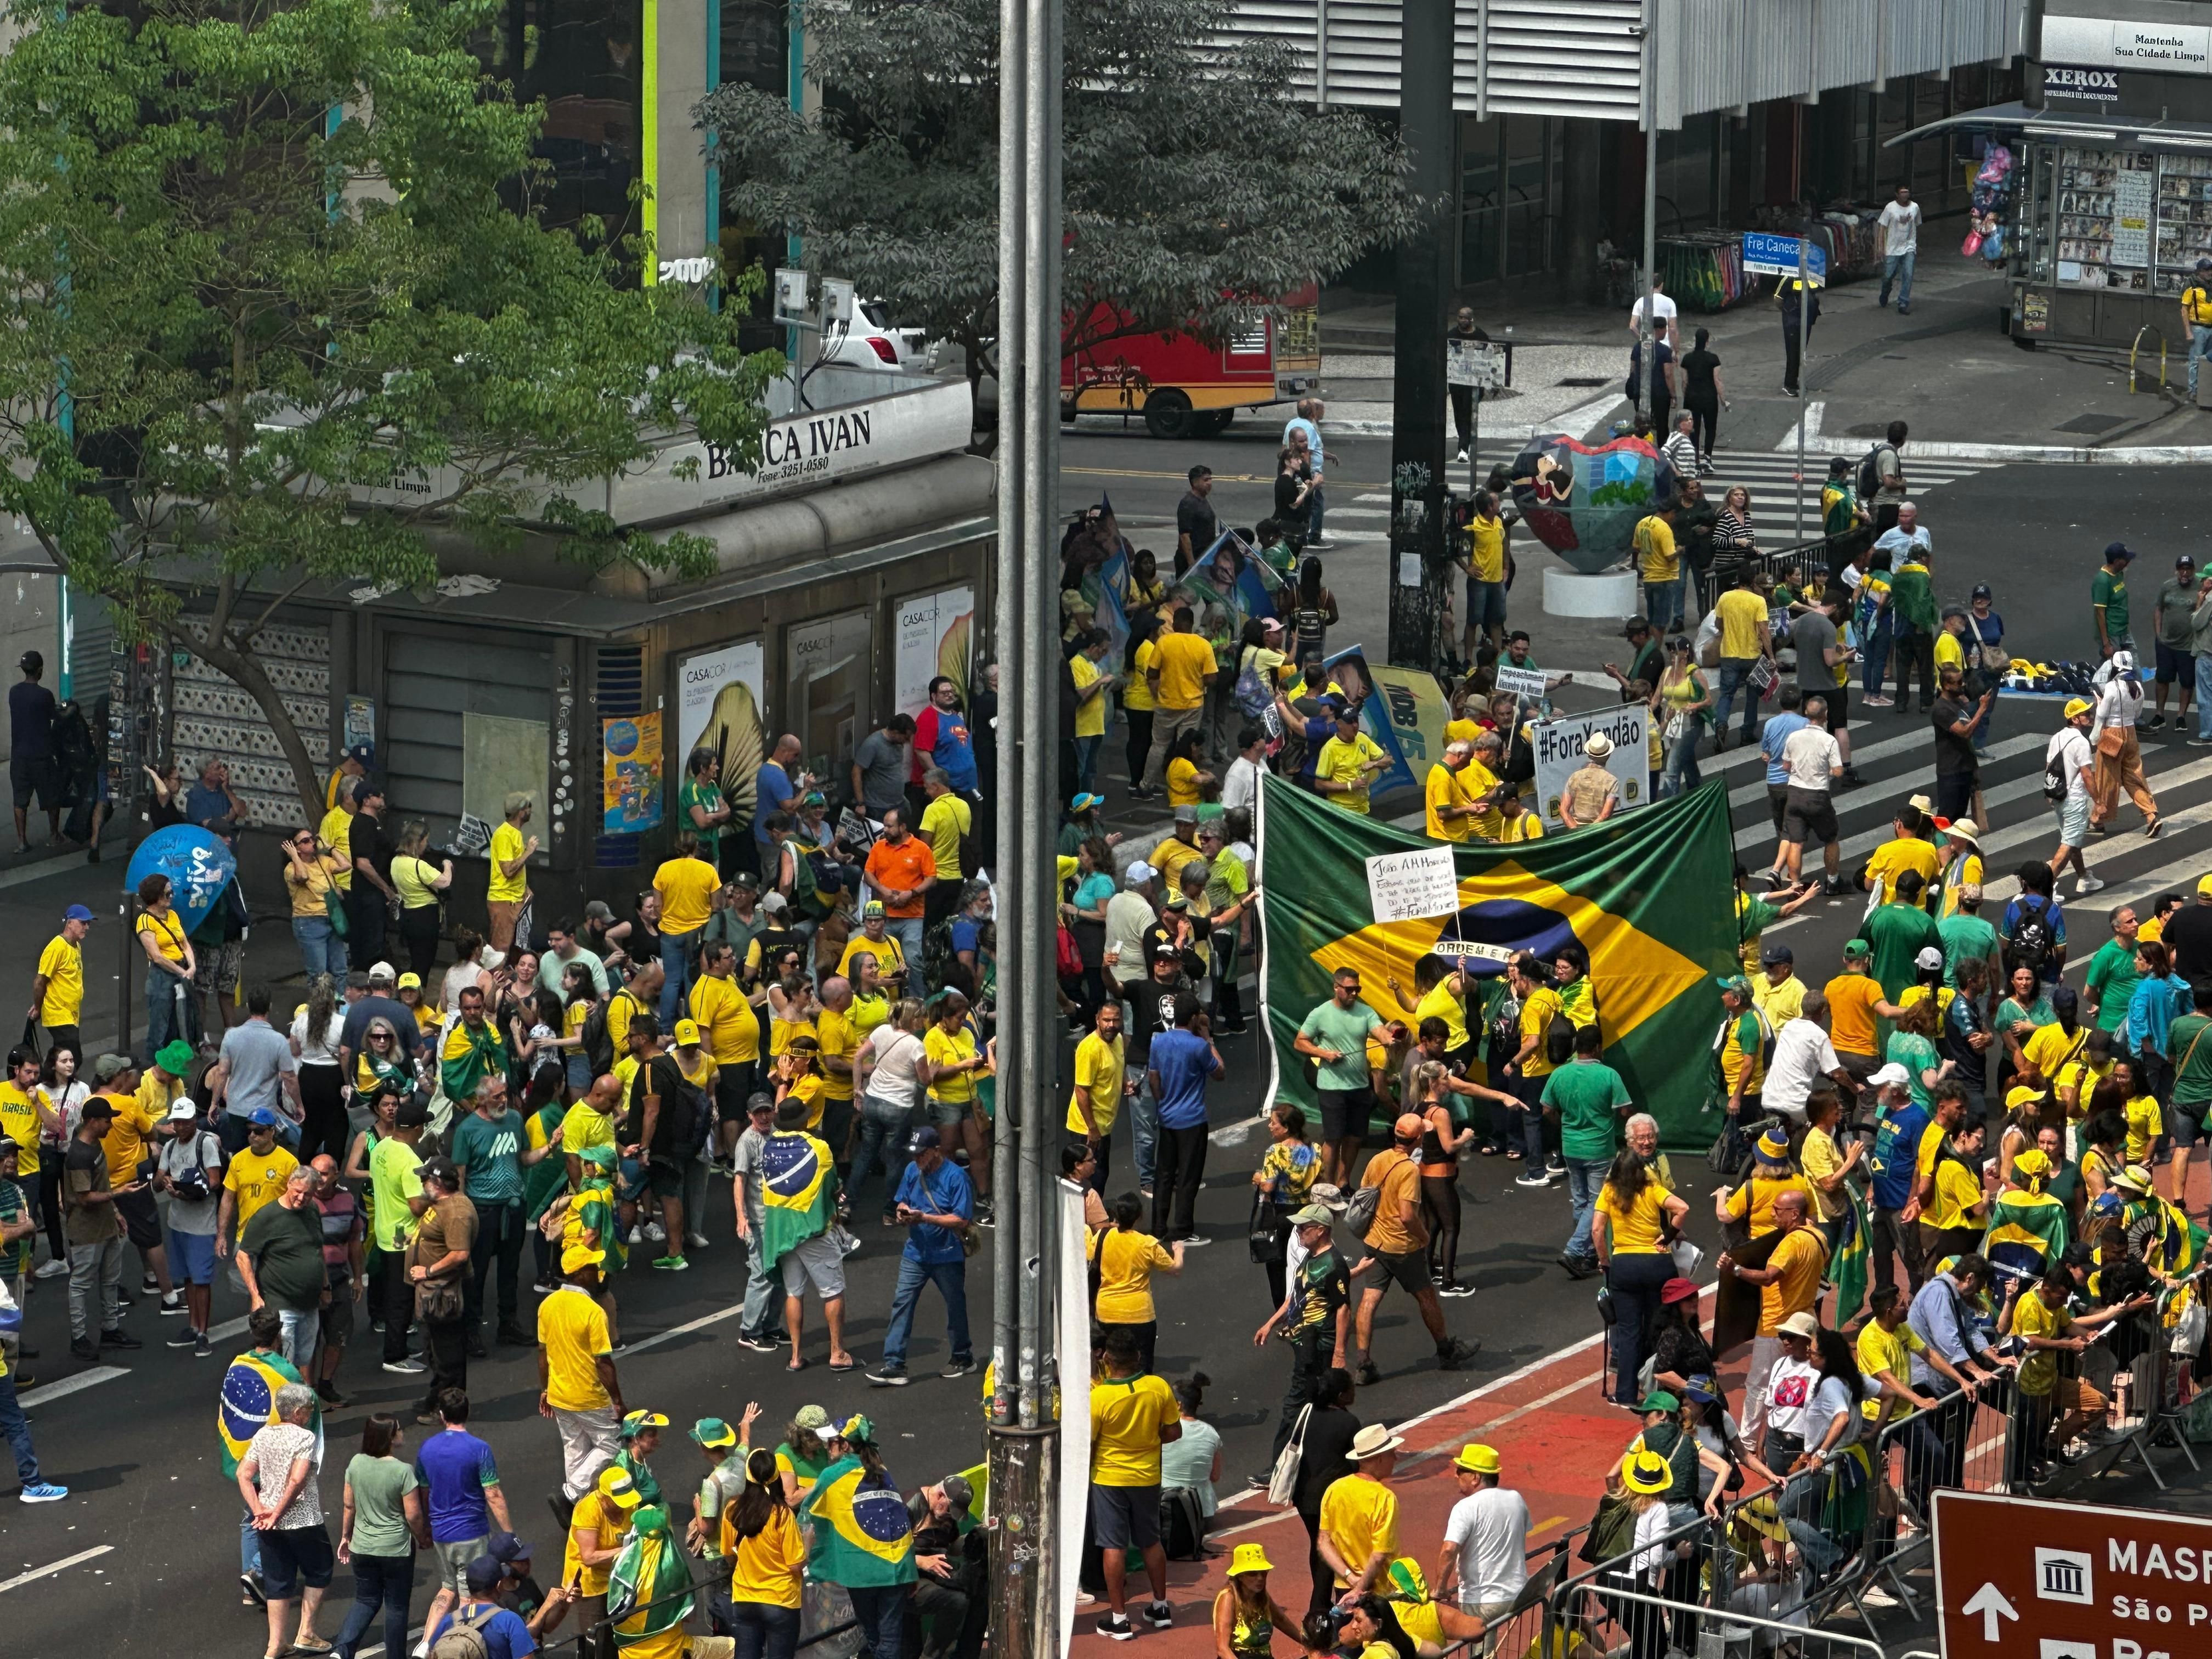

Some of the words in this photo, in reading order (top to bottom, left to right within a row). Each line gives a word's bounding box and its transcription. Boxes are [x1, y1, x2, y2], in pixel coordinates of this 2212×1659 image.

[2045, 68, 2118, 88] XEROX
[1748, 236, 1764, 250] Frei
[1767, 238, 1801, 255] Caneca
[809, 410, 871, 456] IVAN
[187, 847, 212, 899] vivo
[1437, 943, 1485, 955] ORDEM
[251, 1183, 261, 1198] 10
[2112, 1595, 2172, 1623] São
[2188, 1604, 2212, 1626] P
